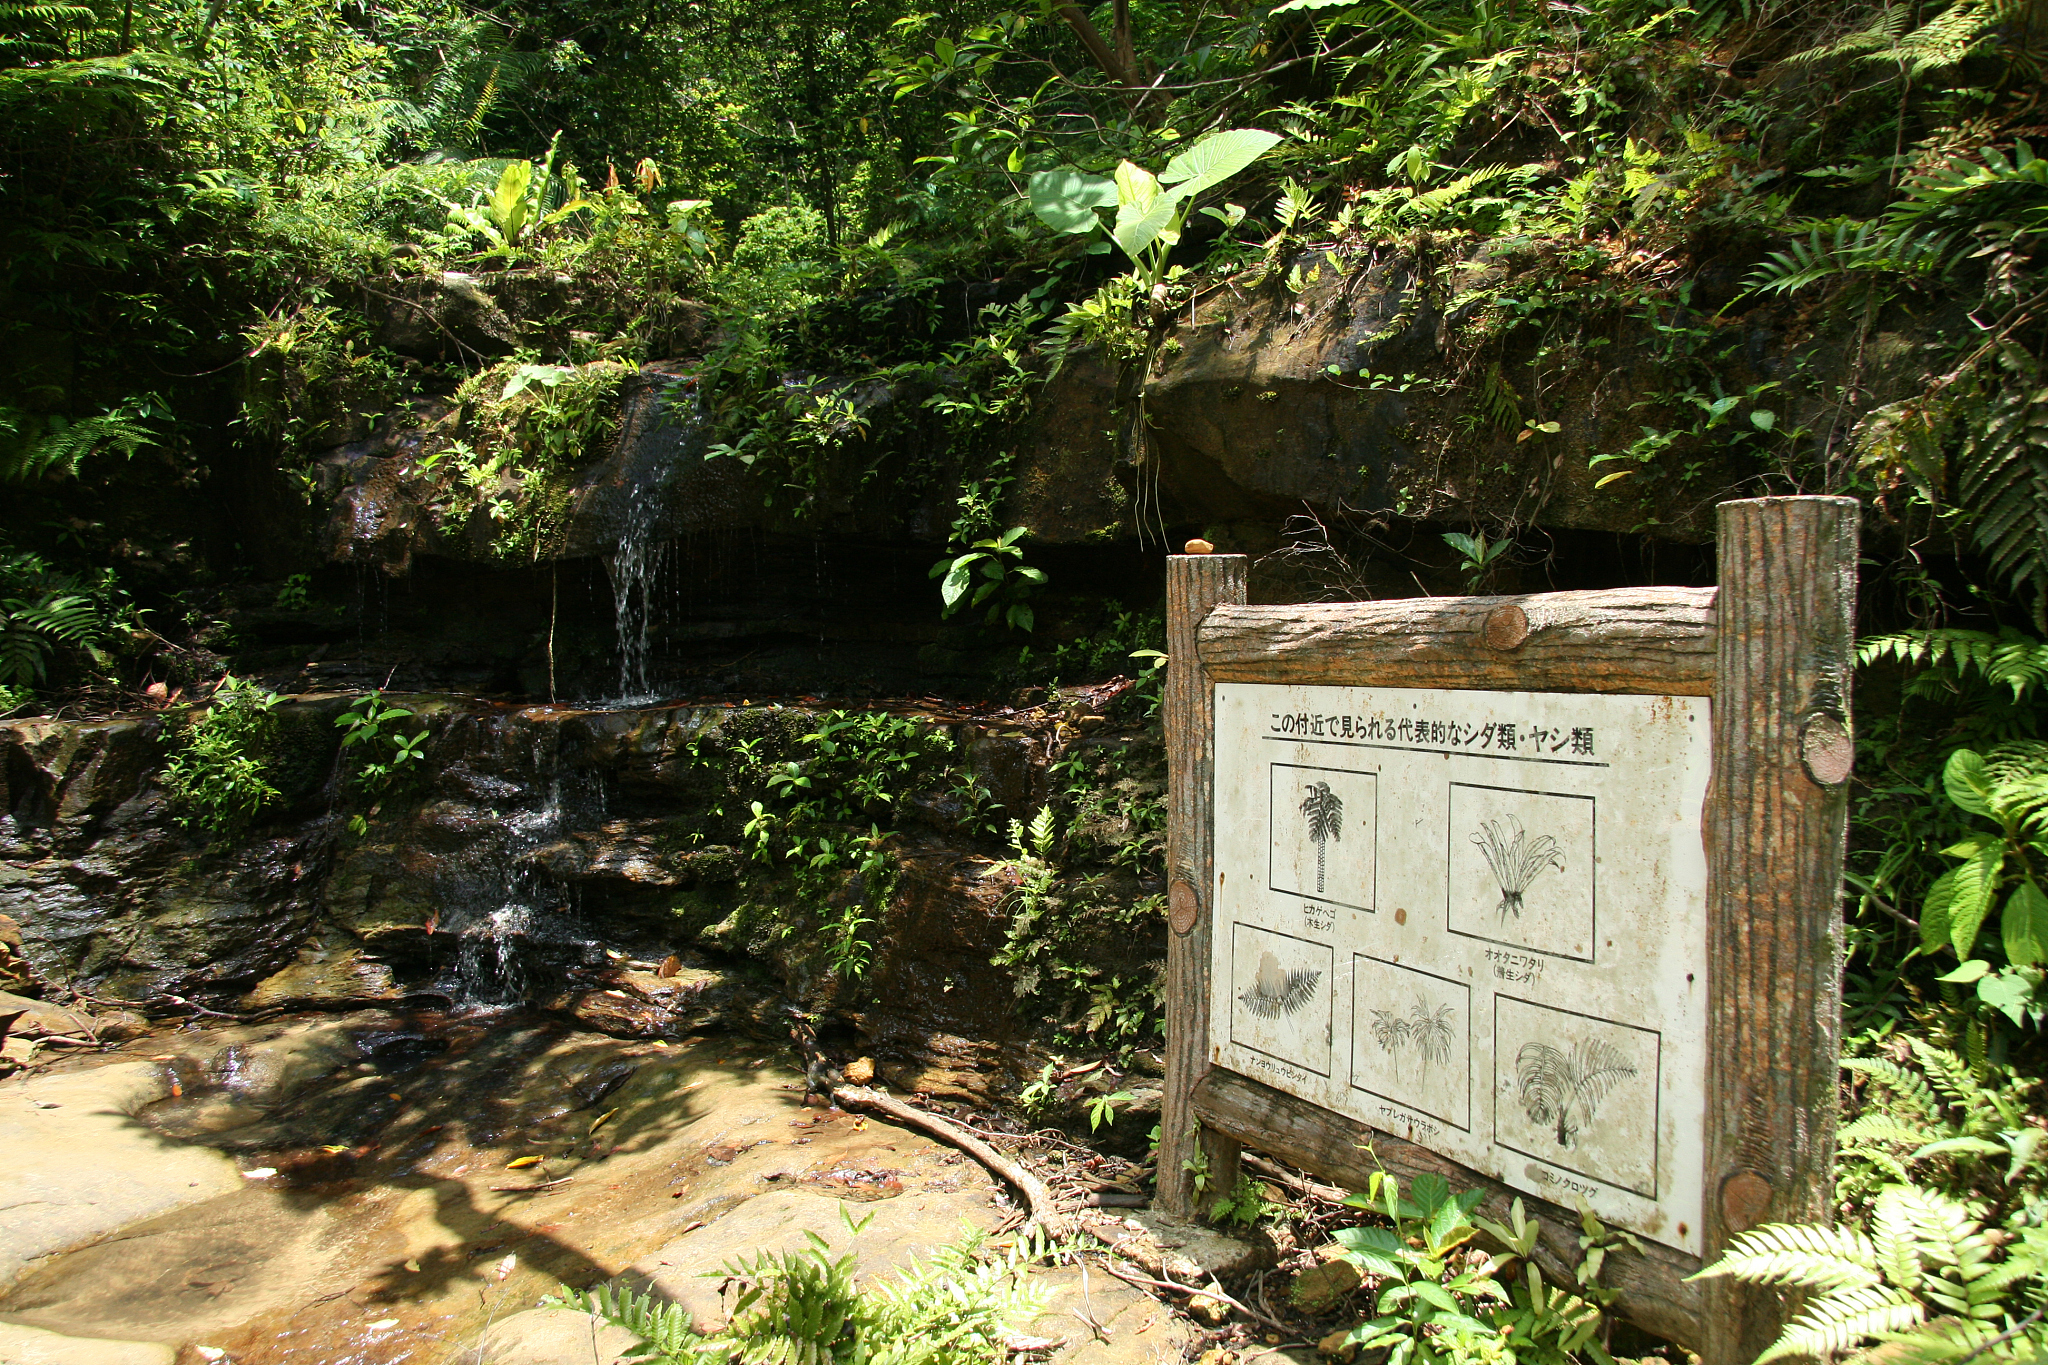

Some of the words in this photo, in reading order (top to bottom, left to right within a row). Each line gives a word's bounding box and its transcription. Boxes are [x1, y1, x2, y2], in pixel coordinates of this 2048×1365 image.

[1270, 713, 1595, 756] この付近で見られる代表的なシダ類・ヤシ類
[1303, 903, 1337, 920] ヒカゲヘゴ
[1484, 947, 1545, 973] オオタニワタリ
